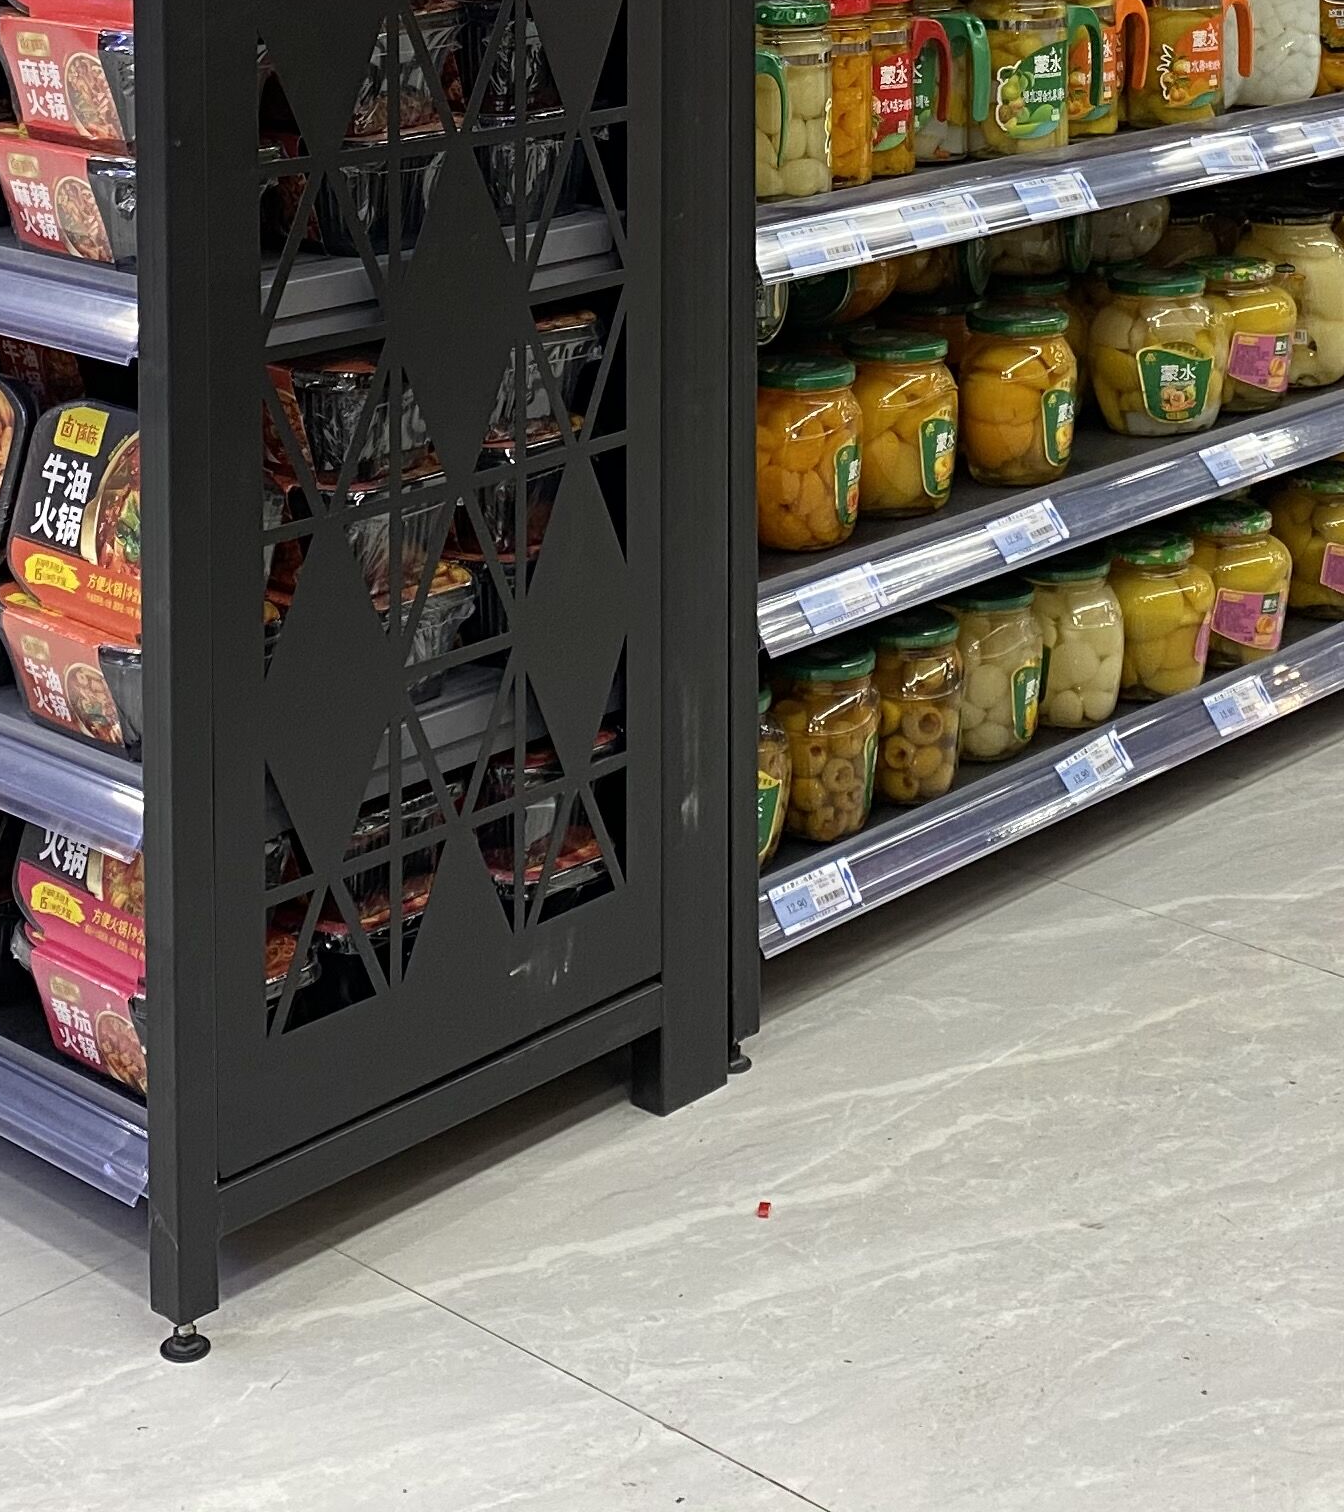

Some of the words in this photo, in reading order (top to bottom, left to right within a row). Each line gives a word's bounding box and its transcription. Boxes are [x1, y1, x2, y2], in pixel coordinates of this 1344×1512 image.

[18, 59, 63, 90] 麻辣
[880, 65, 908, 85] 蒙水
[1034, 53, 1062, 73] 蒙水
[27, 90, 69, 121] 火锅
[10, 179, 53, 211] 麻辣
[20, 210, 60, 242] 火锅
[1160, 364, 1197, 382] 蒙水
[41, 453, 93, 503] 牛油
[30, 496, 83, 548] 火锅
[22, 657, 64, 694] 牛油
[33, 688, 72, 723] 火锅
[51, 998, 93, 1036] 番茄
[60, 1027, 101, 1065] 火锅
